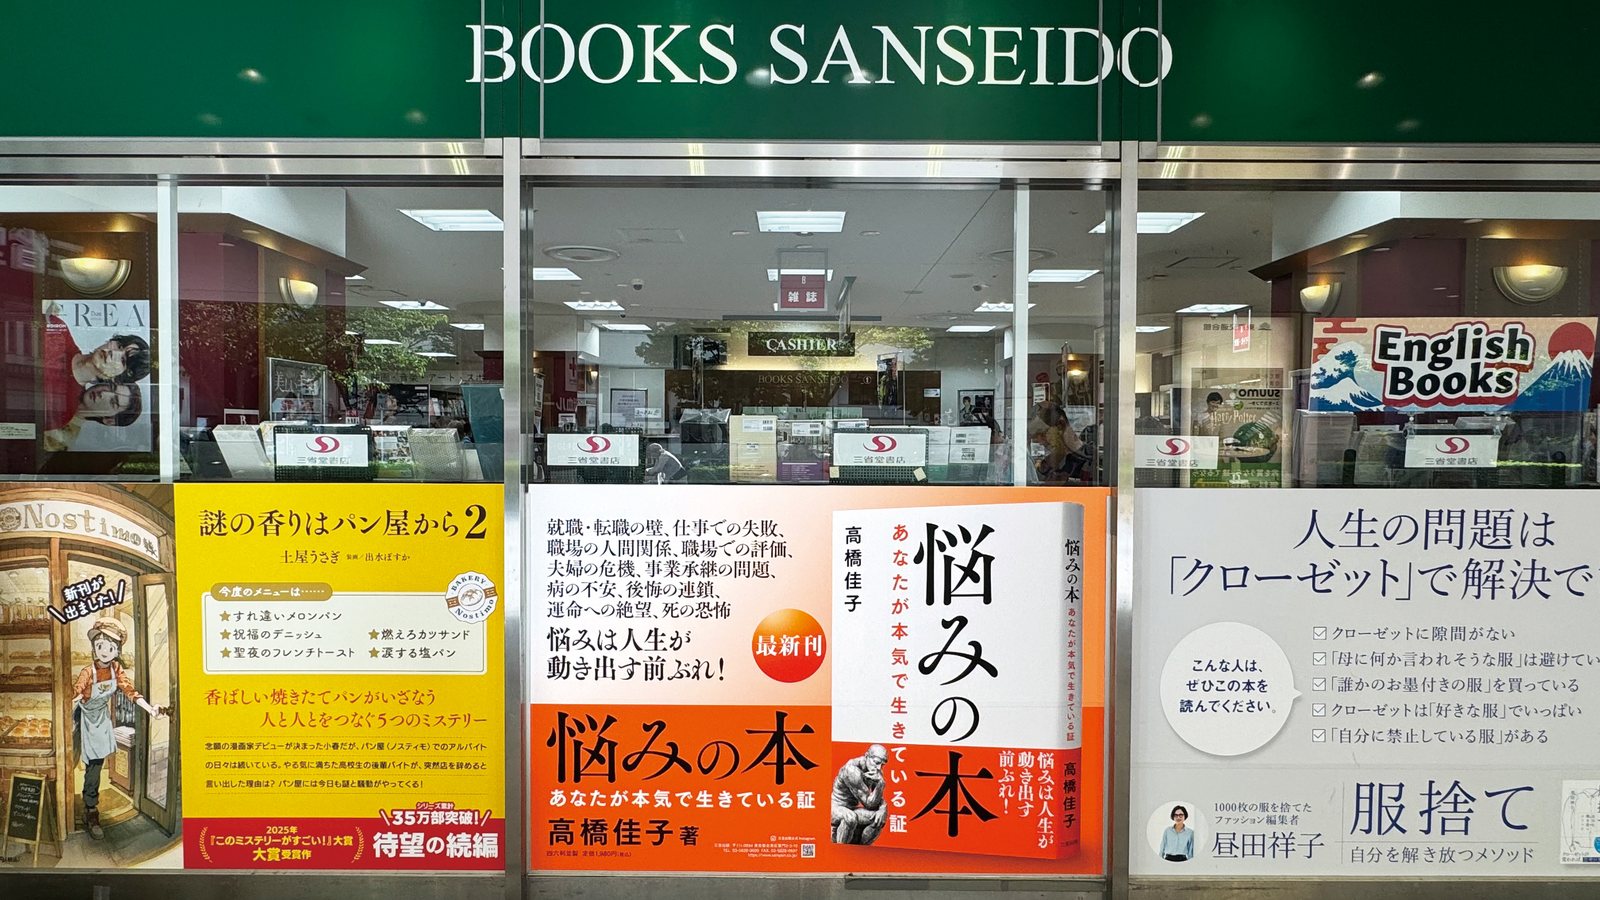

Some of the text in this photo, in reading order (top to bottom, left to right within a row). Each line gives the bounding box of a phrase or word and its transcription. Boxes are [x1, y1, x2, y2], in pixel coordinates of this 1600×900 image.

[465, 24, 1174, 89] BOOKS SANSEIDO
[788, 291, 818, 302] 雑誌
[766, 337, 839, 352] CASHIER
[1379, 326, 1533, 370] English
[758, 375, 793, 384] BOOKS
[1389, 365, 1519, 398] Books
[567, 456, 620, 465] 三省堂書店
[853, 455, 906, 464] 三省堂書店
[1424, 457, 1478, 465] 三省堂書店
[23, 503, 142, 546] Nostimo
[199, 503, 488, 540] 謎の香りはパン屋から2
[547, 518, 786, 538] 就職・転職の壁、仕事での失敗、
[1293, 508, 1556, 551] 人生の問題は
[280, 550, 341, 564] 土屋うさぎ
[547, 540, 794, 558] 職場の人間関係、職場での評価、
[547, 560, 778, 578] 夫婦の危機、事業承継の問題、
[843, 525, 862, 612] 高橋佳子
[1064, 538, 1081, 604] 悩みの本
[451, 575, 487, 592] BAKERY
[1169, 555, 1594, 601] 「クローゼット」で解決で
[64, 577, 105, 602] 新刊が
[547, 580, 722, 598] 病の不安、後悔の連鎖、
[232, 610, 342, 622] すれ違いメロンパン
[455, 599, 495, 620] Nostimo
[547, 601, 732, 619] 運命への絶望、死の恐怖
[232, 628, 323, 641] 祝福のデニッシュ
[381, 629, 471, 641] 燃えろカツサンド
[547, 627, 693, 653] 悩みは人生が
[1331, 625, 1516, 643] クローゼットに隙間がない
[233, 646, 356, 660] 聖夜のフレンチトースト
[381, 648, 457, 660] 涙する塩パン
[756, 634, 823, 657] 最新刊
[1192, 658, 1264, 673] こんな人は、
[1331, 651, 1600, 668] 「母に何か言われそうな服」は避けてい
[547, 656, 726, 682] 動き出す前ぶれ！
[1065, 607, 1076, 742] あなたが本気で生きている証
[889, 523, 909, 834] あなたが本気で生きている証
[911, 522, 1000, 838] 悩みの本
[1186, 678, 1269, 693] ぜひこの本を
[1331, 677, 1581, 694] 「誰かのお墨付きの服」を買っている
[205, 689, 436, 706] 香ばしい焼きたてパンがいざなう
[1180, 699, 1277, 714] 読んでください。
[260, 712, 488, 729] 人と人とをつなぐ5つのミステリー
[1331, 703, 1582, 720] クローゼットは「好きな服」でいっぱい
[1331, 728, 1549, 745] 「自分に禁止している服」がある
[547, 711, 820, 786] 悩みの本
[1017, 752, 1035, 818] 動き出す
[549, 790, 816, 809] あなたが本気で生きている証
[1037, 753, 1055, 849] 悩みは人生が
[1062, 761, 1077, 829] 高橋佳子
[1213, 802, 1312, 813] 1000枚の服を捨てた
[1350, 780, 1536, 836] 服捨て
[392, 810, 480, 826] 35万部突破！
[1214, 814, 1300, 826] ファッション編集者
[266, 825, 298, 834] 2025年
[548, 818, 699, 846] 高橋佳子 著
[372, 832, 499, 858] 待望の続編
[1211, 831, 1325, 859] 昼田祥子
[252, 848, 312, 862] 大賞受賞作
[1350, 847, 1534, 864] 自分を解き放つメソッド
